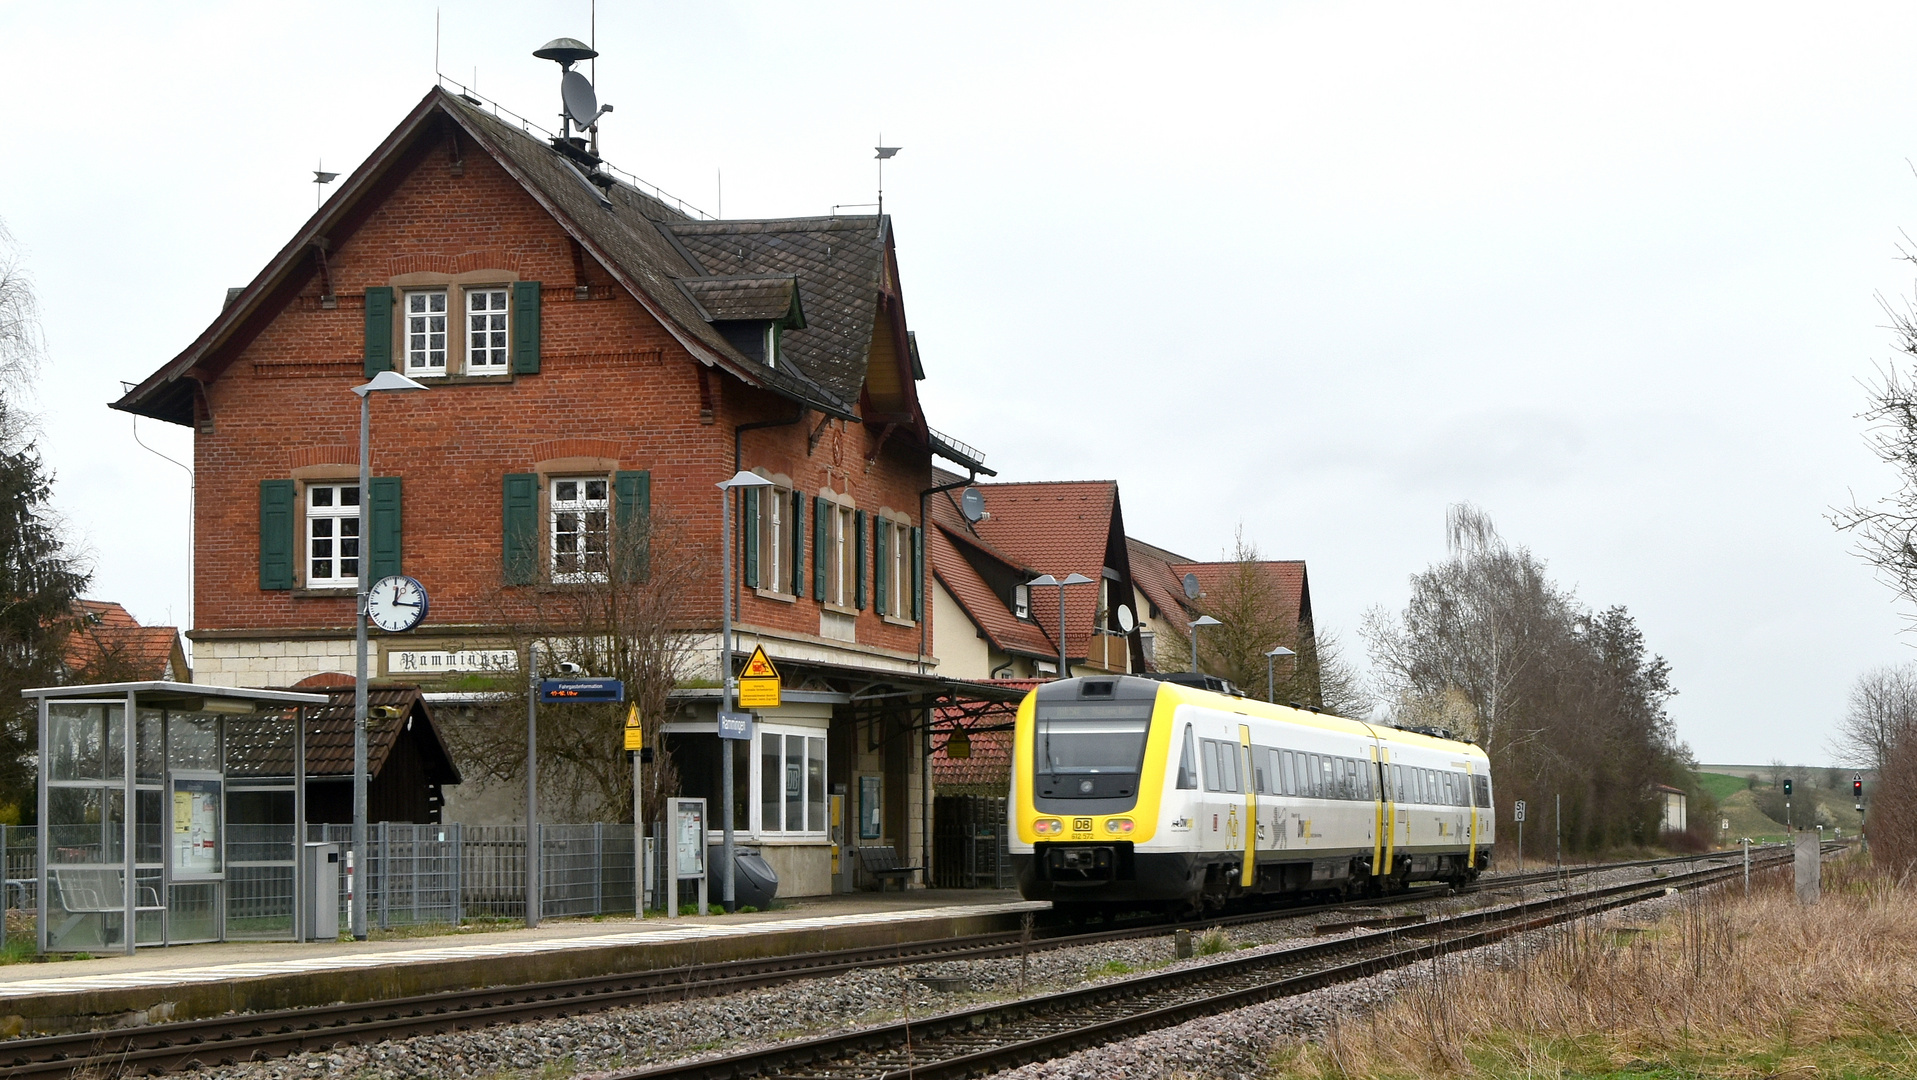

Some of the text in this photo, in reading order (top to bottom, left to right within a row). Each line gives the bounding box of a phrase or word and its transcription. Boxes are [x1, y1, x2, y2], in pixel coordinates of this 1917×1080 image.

[401, 652, 509, 670] Rammingen
[722, 715, 746, 734] Rammingen
[1516, 802, 1524, 810] 51
[1517, 811, 1523, 819] 0
[1075, 820, 1090, 829] DB
